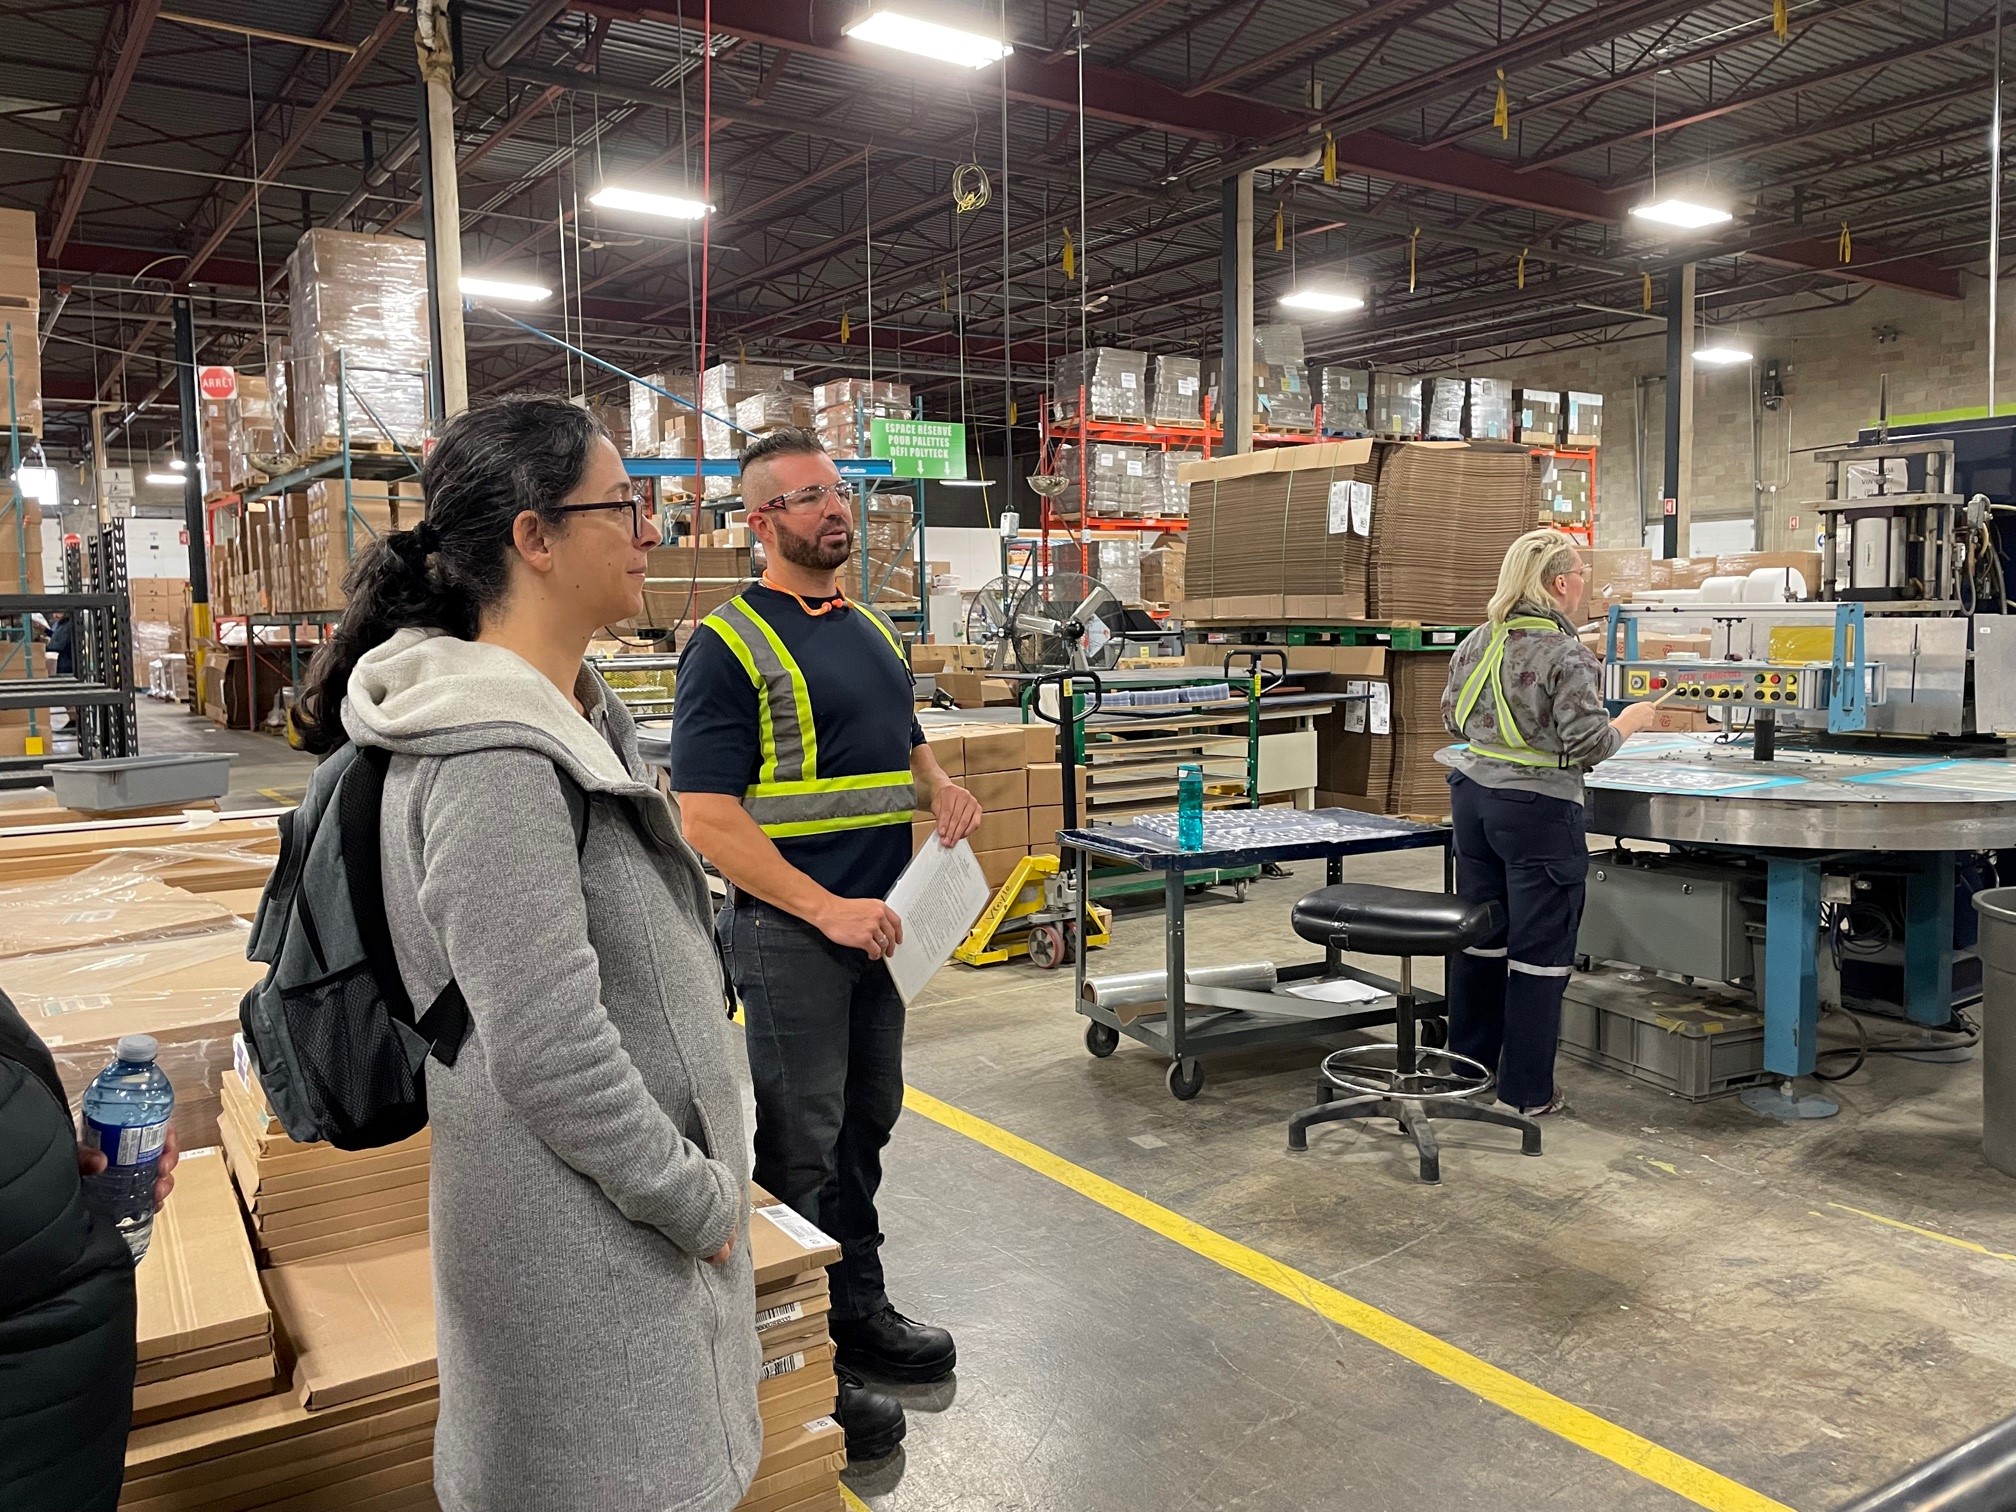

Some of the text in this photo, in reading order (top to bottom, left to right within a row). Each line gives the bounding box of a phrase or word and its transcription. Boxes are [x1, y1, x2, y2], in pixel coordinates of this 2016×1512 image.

[203, 376, 233, 388] ARRÊT
[885, 423, 952, 436] ESPACE RÉSERVÉ
[888, 435, 950, 447] POUR PALETTES
[890, 446, 907, 457] DÉFI
